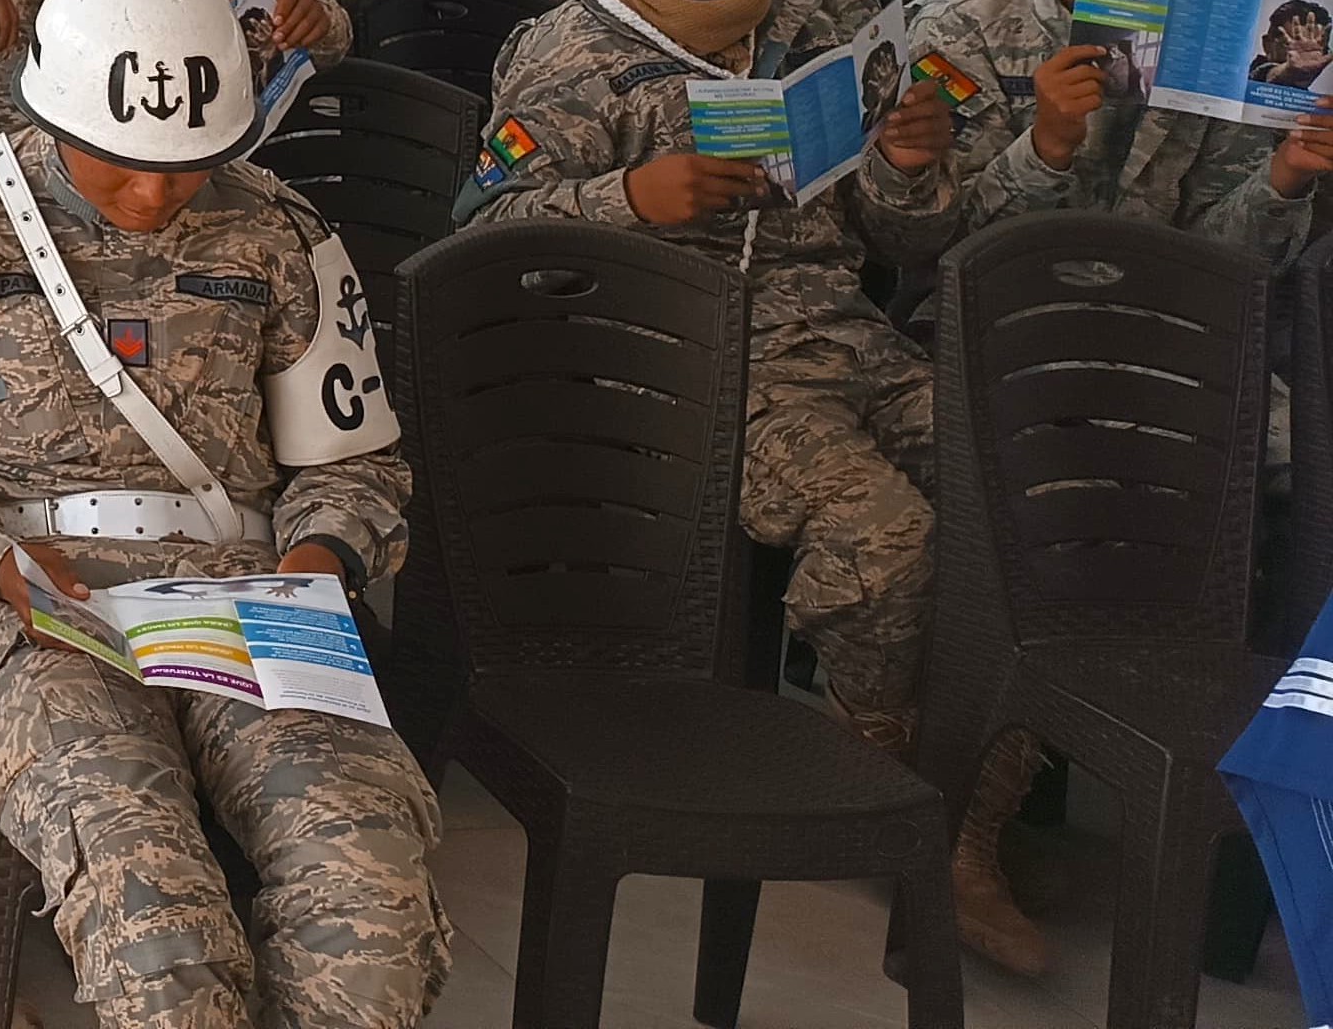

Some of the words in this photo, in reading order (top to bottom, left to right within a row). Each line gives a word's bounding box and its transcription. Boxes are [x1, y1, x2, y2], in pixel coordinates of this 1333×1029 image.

[108, 51, 139, 124] C
[184, 56, 220, 129] P
[203, 280, 266, 302] ARMADA
